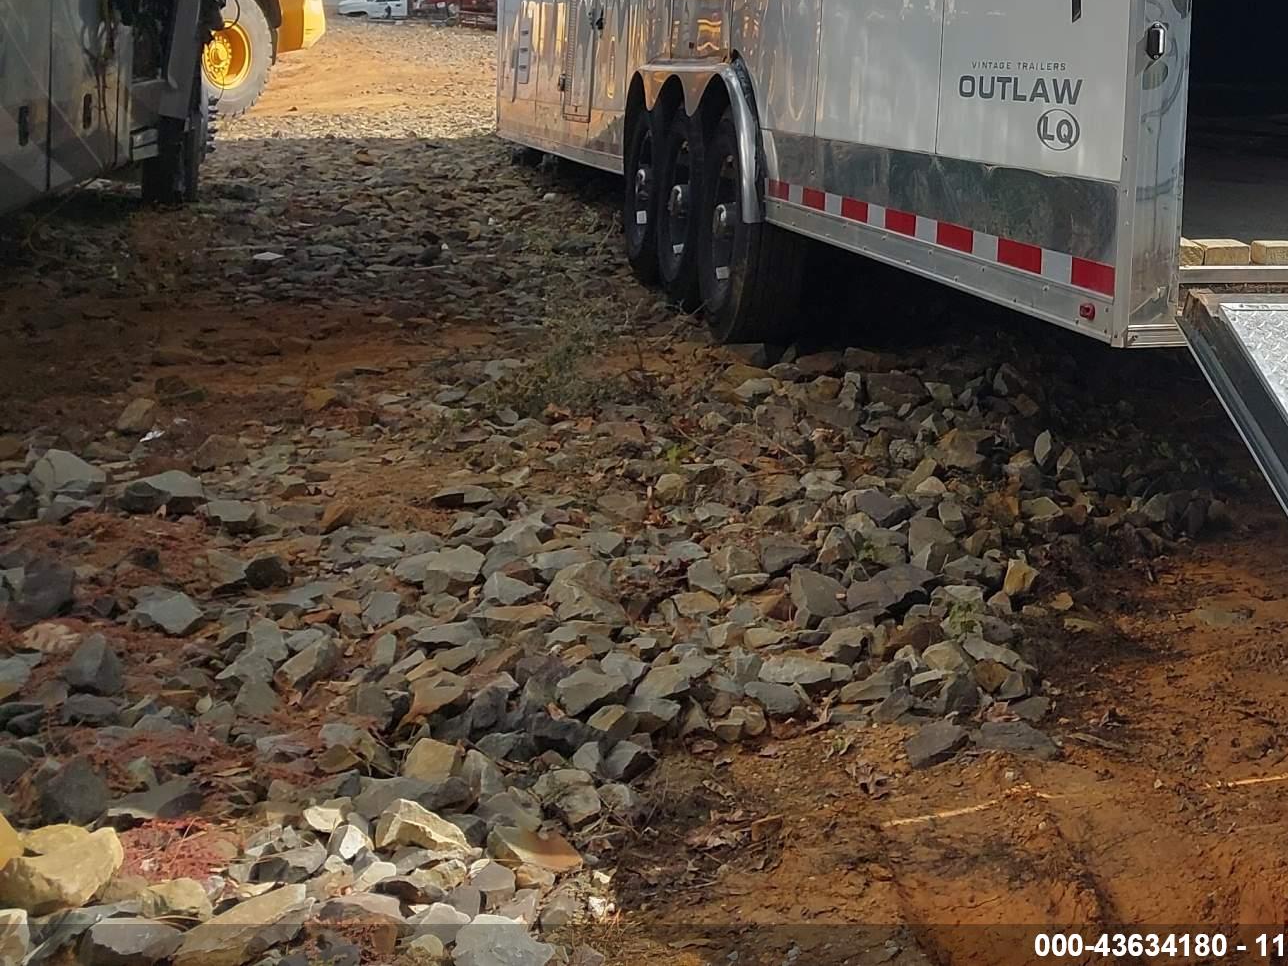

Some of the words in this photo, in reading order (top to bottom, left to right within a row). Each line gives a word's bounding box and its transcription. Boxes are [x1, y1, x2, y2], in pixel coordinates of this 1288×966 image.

[971, 61, 1012, 70] VINTAGE
[1017, 62, 1066, 71] TRAILERS
[958, 75, 1083, 105] OUTLAW
[1041, 115, 1074, 147] LQ
